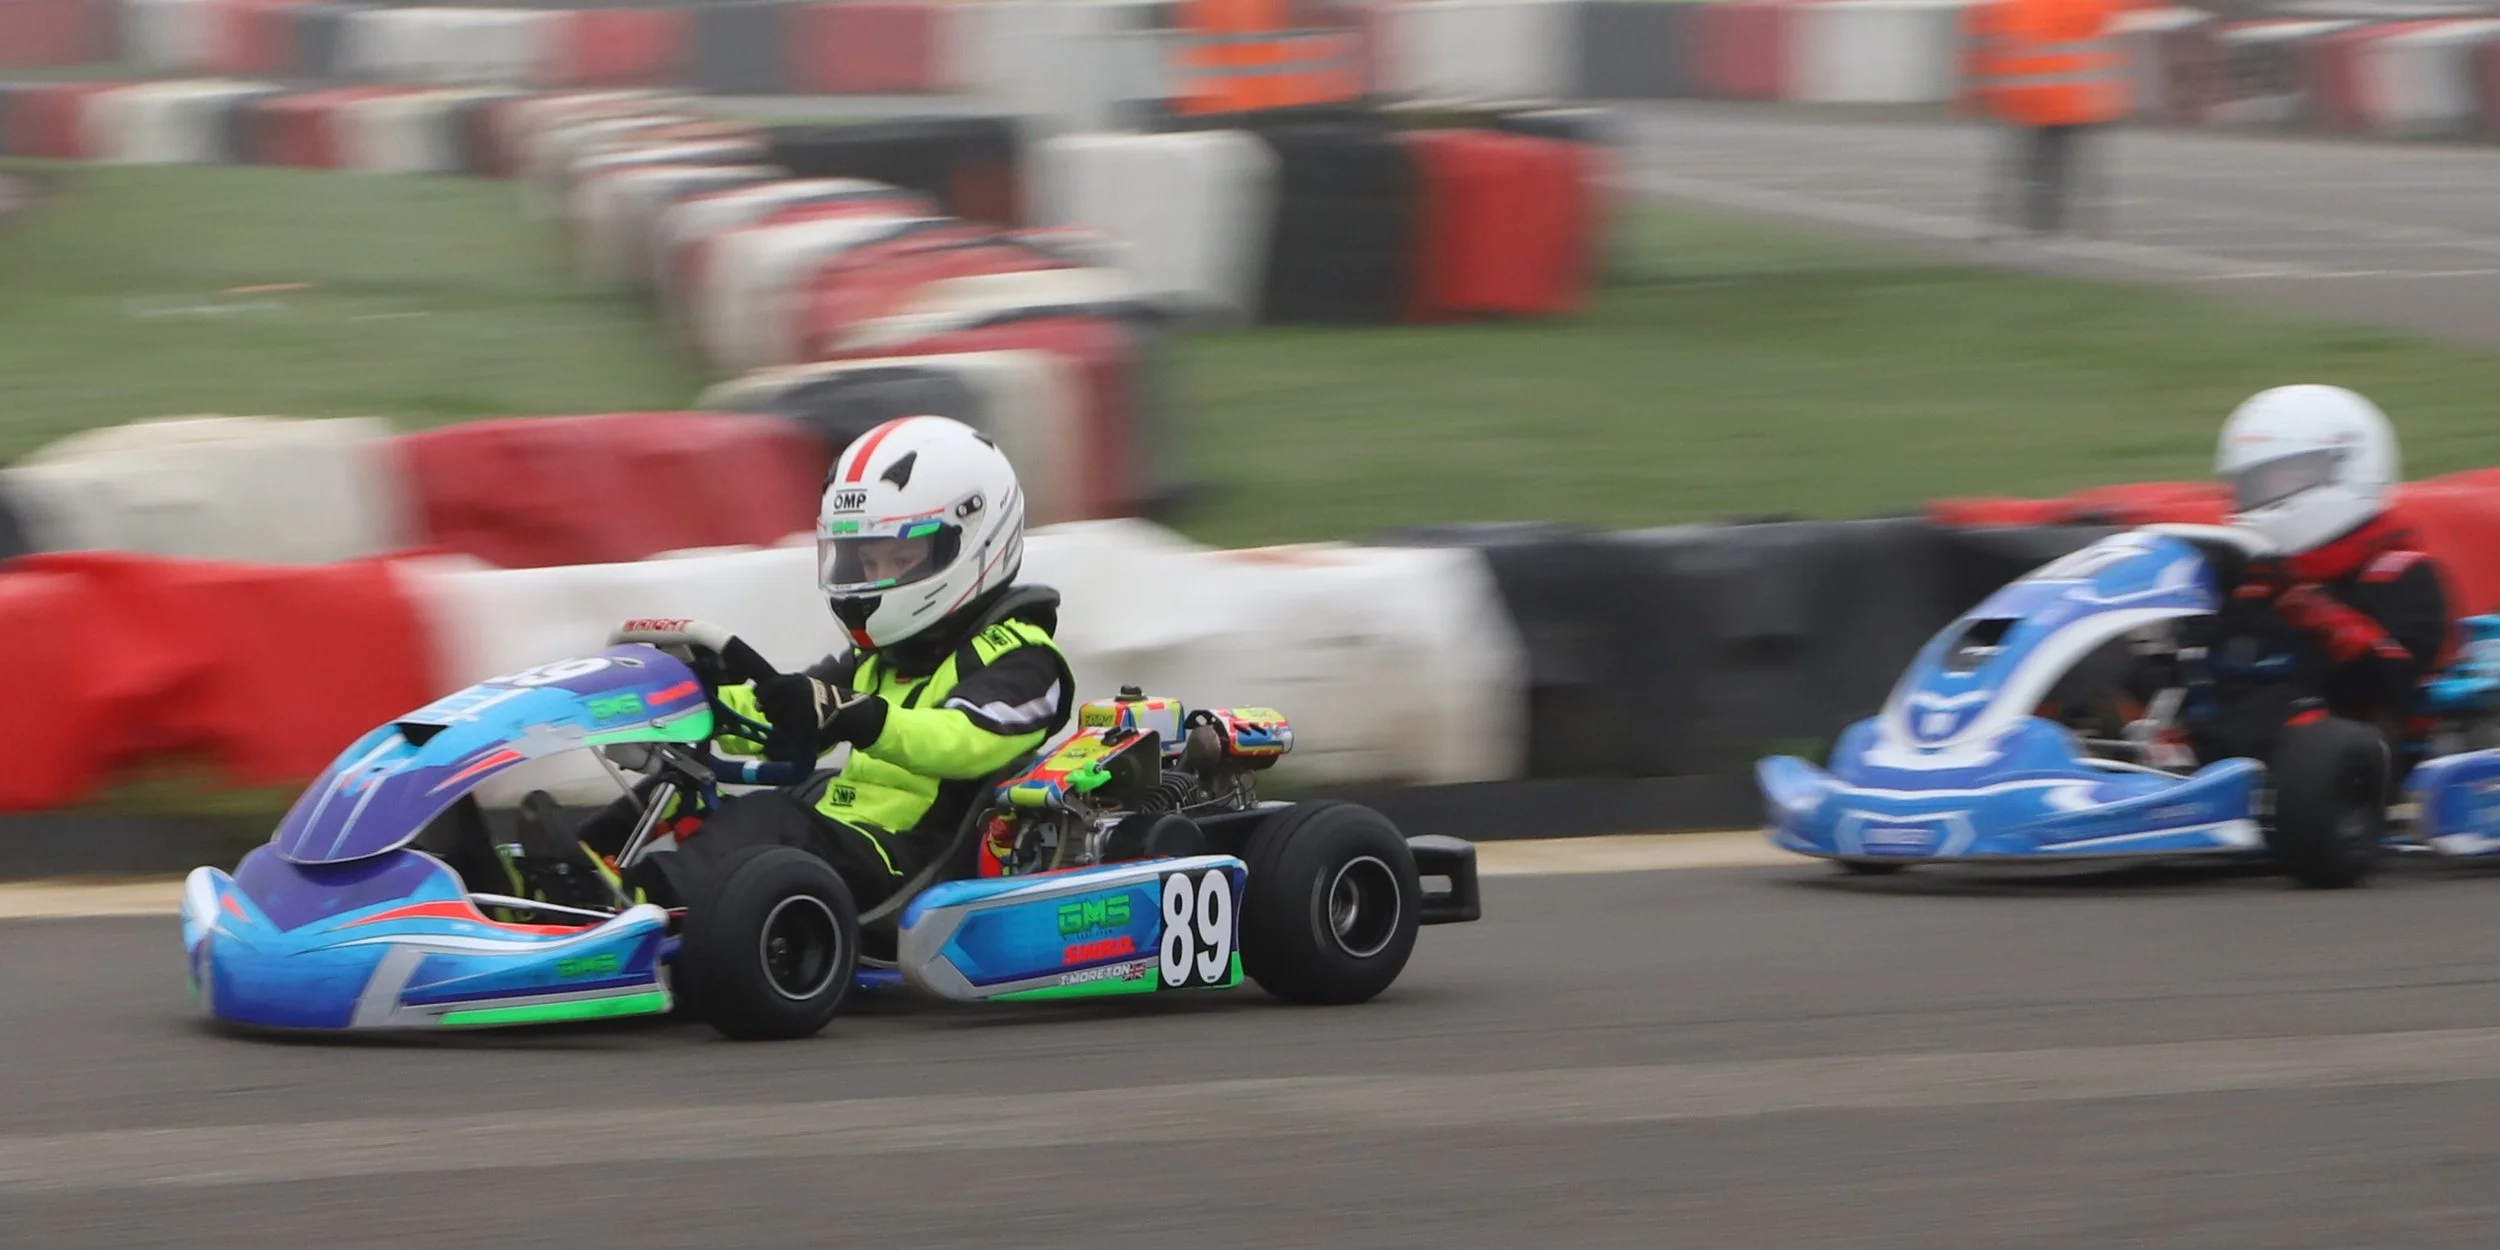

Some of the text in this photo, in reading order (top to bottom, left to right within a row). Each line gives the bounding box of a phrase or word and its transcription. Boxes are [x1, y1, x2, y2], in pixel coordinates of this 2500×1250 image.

[833, 492, 867, 510] OMP
[832, 788, 856, 803] OMP
[1057, 893, 1131, 938] GMS
[1160, 869, 1232, 987] 89
